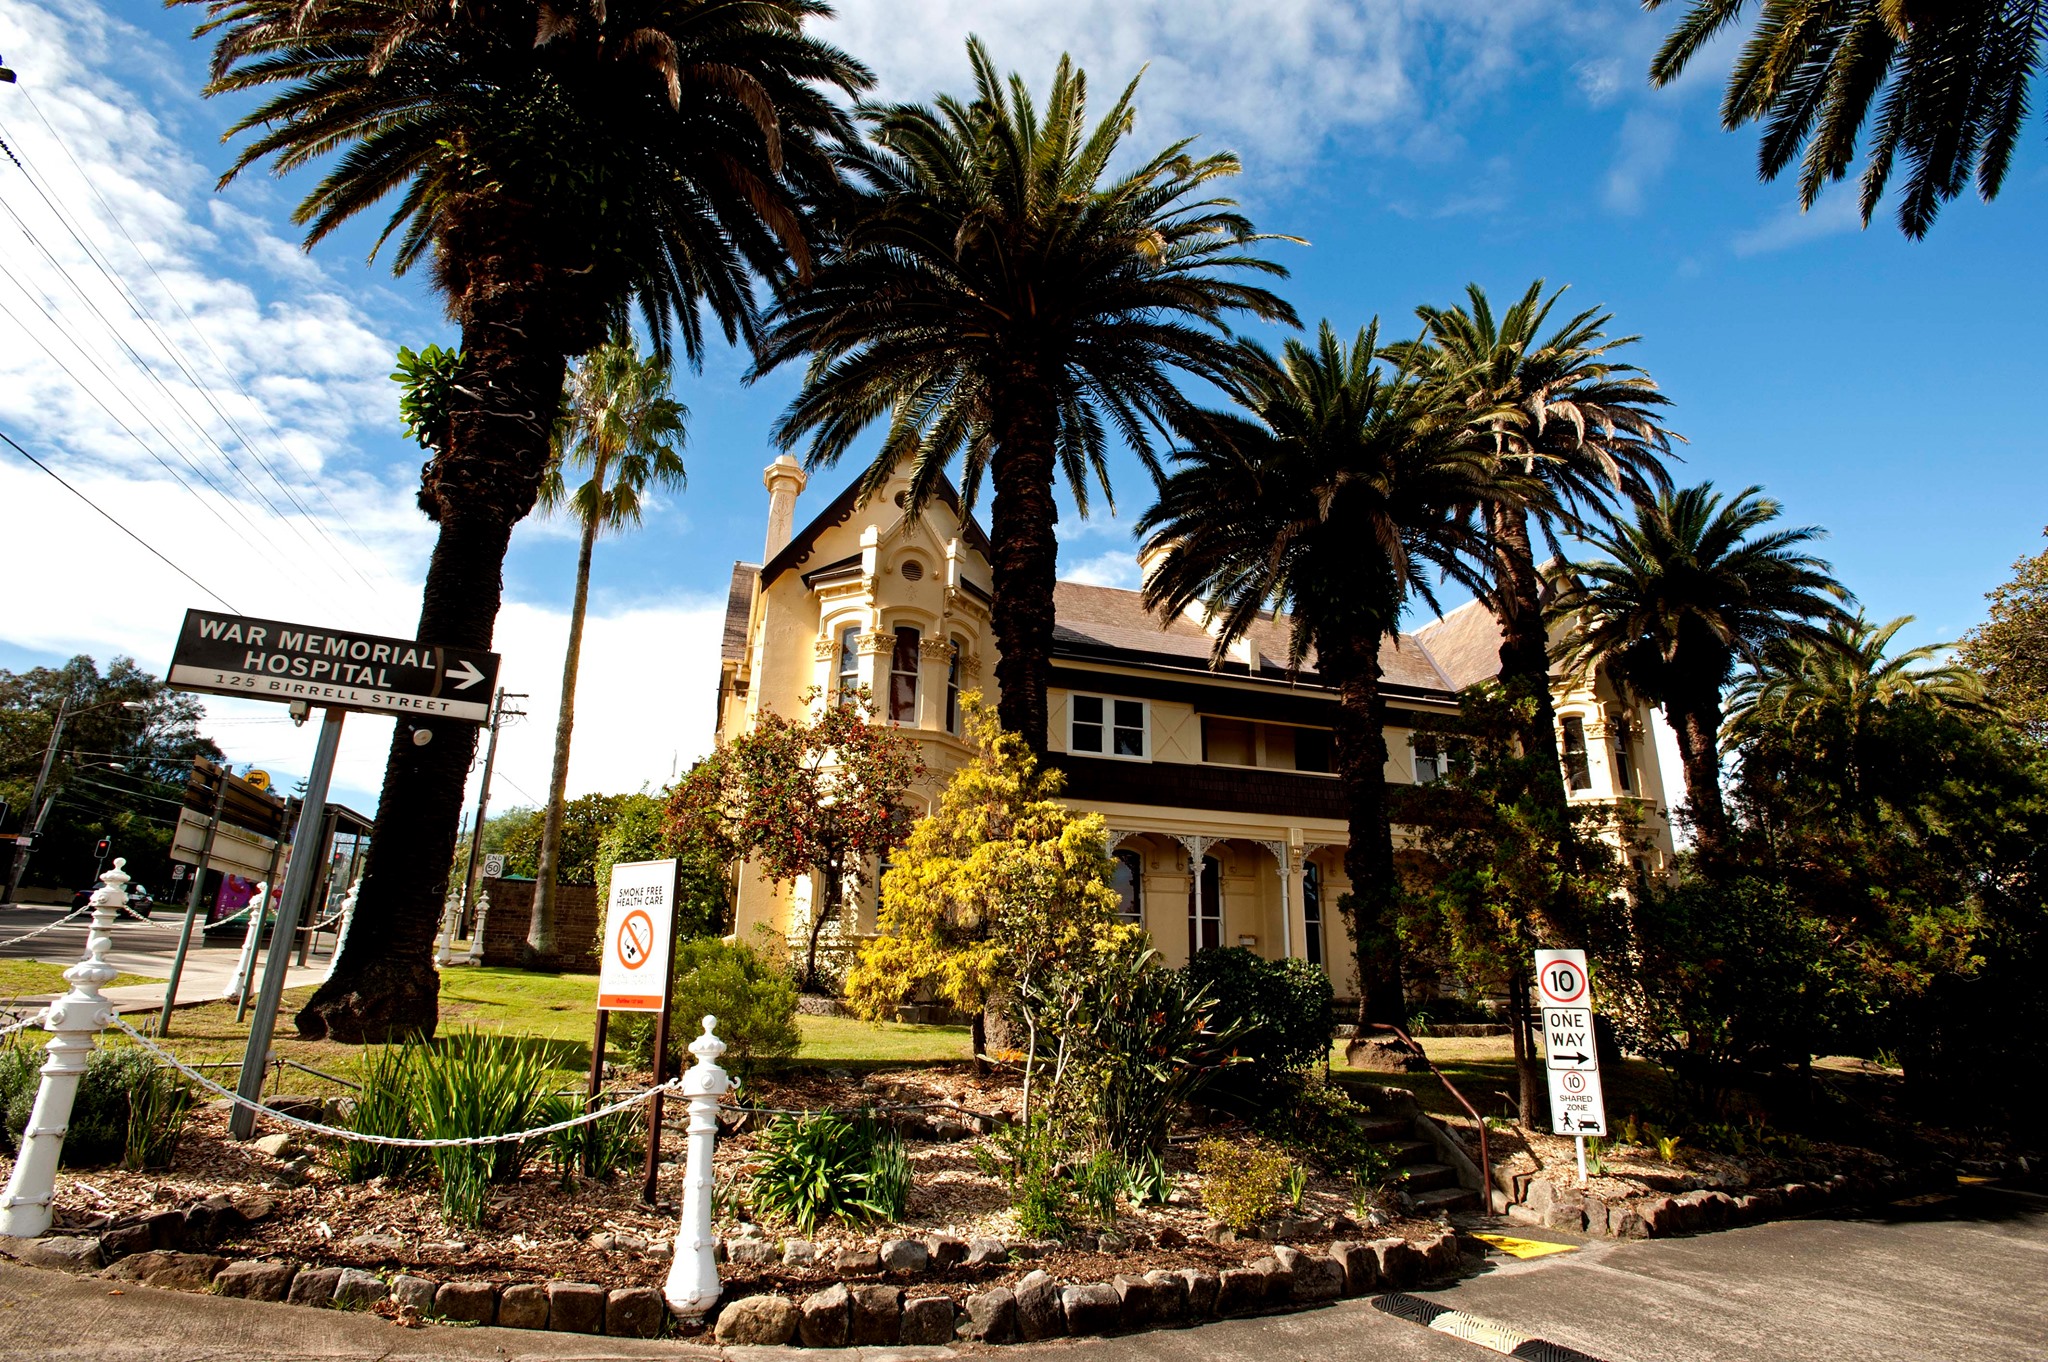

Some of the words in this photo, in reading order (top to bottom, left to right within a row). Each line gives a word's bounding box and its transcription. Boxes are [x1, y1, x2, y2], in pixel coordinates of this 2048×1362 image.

[199, 618, 267, 647] WAR
[278, 630, 436, 670] MEMORIAL
[243, 650, 392, 688] HOSPITAL
[215, 674, 256, 688] 125
[269, 681, 359, 701] BIRRELL
[372, 693, 450, 712] STREET
[487, 864, 499, 872] 50
[619, 887, 644, 898] SMOKE
[646, 885, 663, 896] FREE
[616, 897, 643, 907] HEALTH
[644, 895, 664, 906] CARE
[1550, 970, 1575, 992] 10
[1550, 1013, 1584, 1028] ONE
[1552, 1032, 1586, 1047] WAY
[1568, 1076, 1580, 1088] 10
[1559, 1094, 1593, 1103] SHARED
[1566, 1103, 1588, 1111] ZONE
